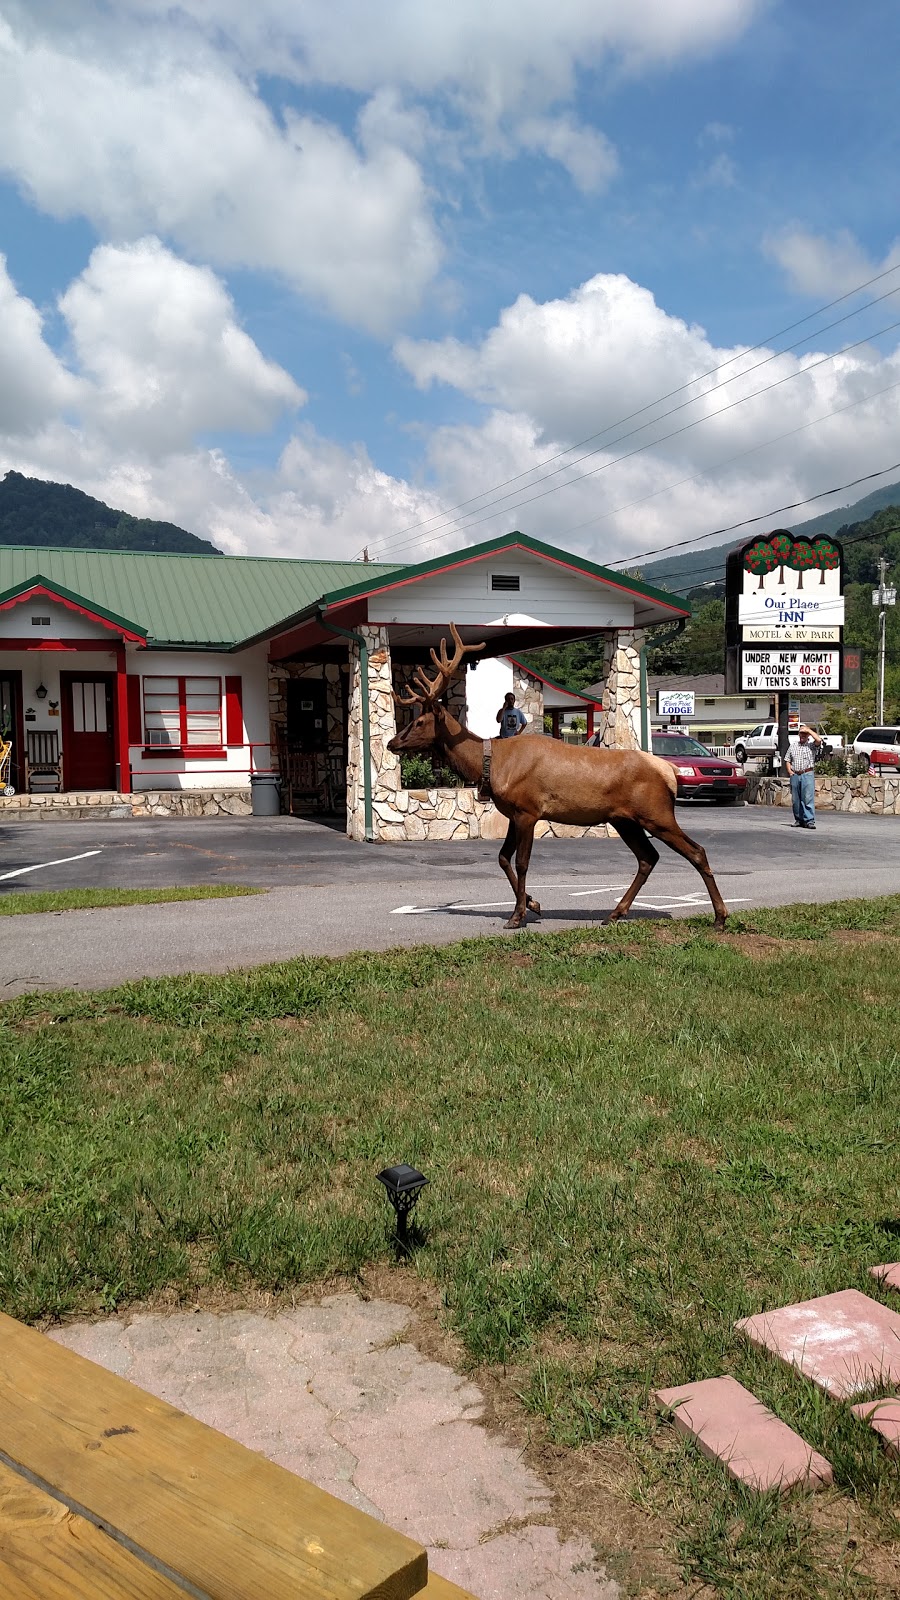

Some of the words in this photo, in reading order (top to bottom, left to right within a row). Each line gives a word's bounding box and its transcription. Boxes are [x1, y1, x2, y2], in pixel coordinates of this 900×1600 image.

[764, 597, 786, 609] Our
[789, 598, 820, 609] Place
[778, 611, 805, 622] INN
[749, 630, 782, 639] MOTEL
[784, 630, 793, 639] &
[796, 631, 808, 639] RV
[810, 631, 835, 640] PARK
[745, 652, 771, 663] UNDER
[779, 652, 797, 663] NEW
[802, 652, 832, 663] MGMT!
[844, 654, 859, 669] YES
[760, 664, 791, 675] ROOMS
[793, 676, 799, 687] &
[801, 676, 832, 687] BRKFST
